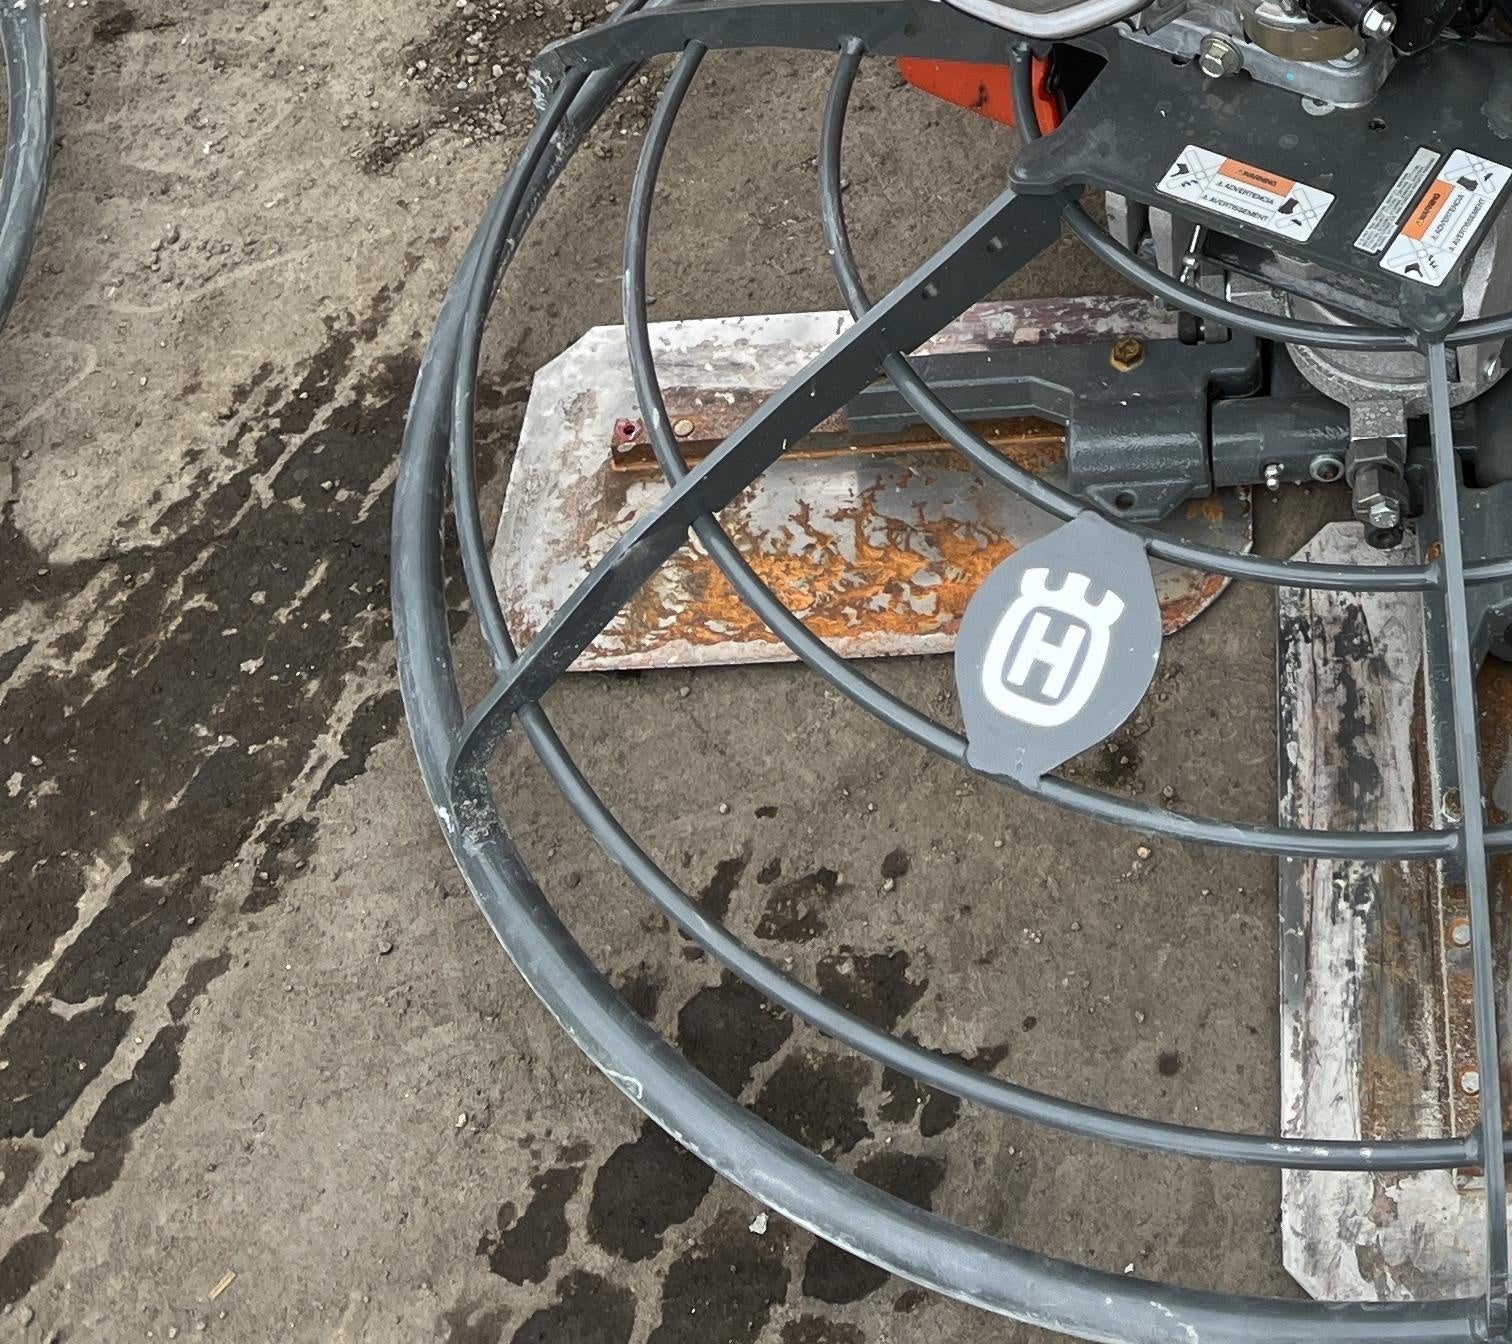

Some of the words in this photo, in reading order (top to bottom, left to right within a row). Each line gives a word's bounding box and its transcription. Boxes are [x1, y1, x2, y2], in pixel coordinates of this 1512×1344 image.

[1242, 168, 1278, 188] WARNING
[1209, 194, 1269, 223] AVERTISSEMENT
[1224, 182, 1275, 206] ADVERTENCIA
[1434, 193, 1466, 236] ADVERTENCIA
[1453, 197, 1486, 247] AVERTISSEMENT
